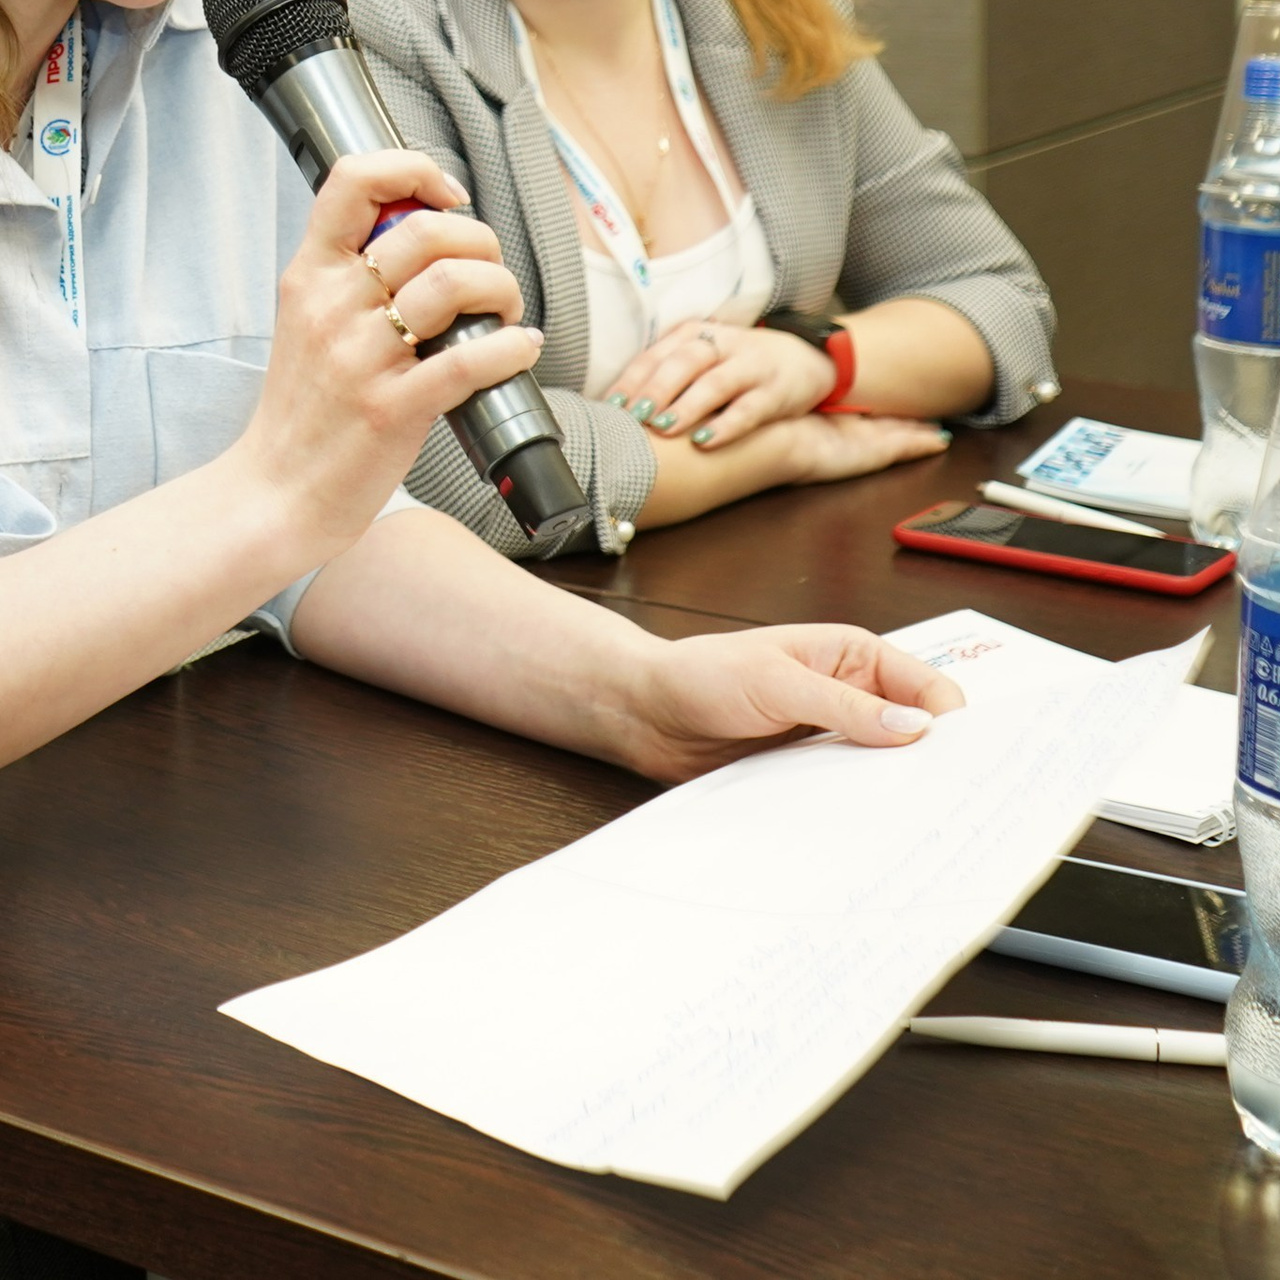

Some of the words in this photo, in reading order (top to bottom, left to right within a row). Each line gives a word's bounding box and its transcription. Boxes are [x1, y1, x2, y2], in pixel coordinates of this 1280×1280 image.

[66, 194, 75, 242] ЗДОРОВЬЯ
[68, 245, 78, 300] ТЕРРИТОРИЯ
[1257, 683, 1280, 707] 0.6
